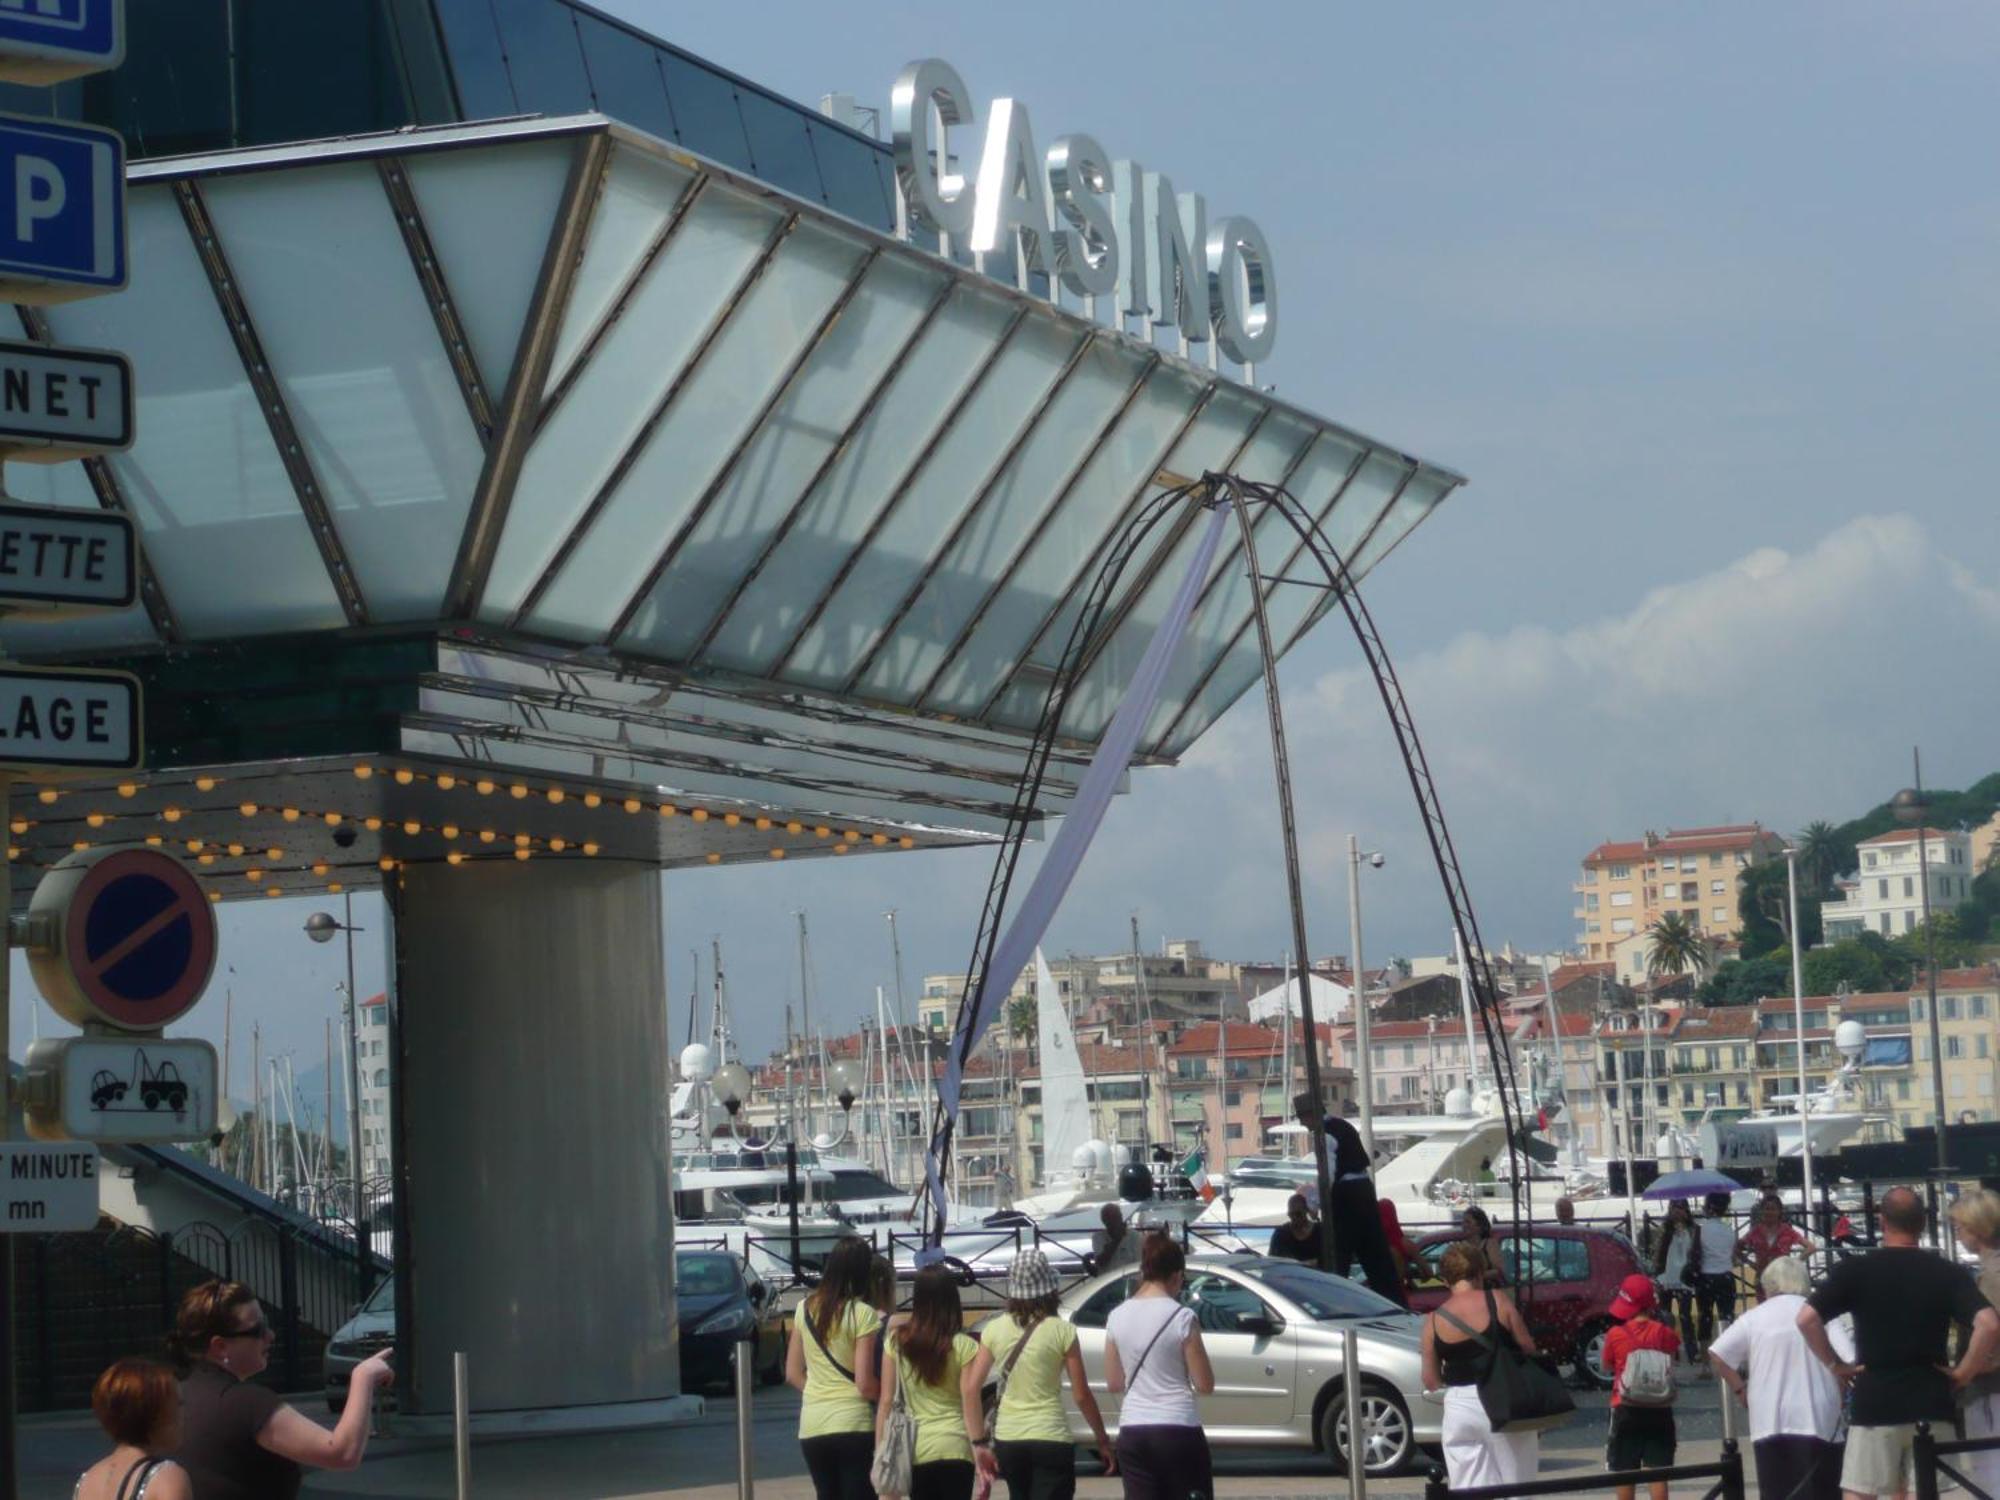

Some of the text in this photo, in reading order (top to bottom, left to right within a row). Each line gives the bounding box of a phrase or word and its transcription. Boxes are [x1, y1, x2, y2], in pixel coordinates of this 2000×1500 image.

[15, 153, 66, 243] P
[892, 57, 1277, 364] CASINO
[4, 368, 102, 420] NET
[0, 531, 107, 581] ETTE
[11, 1153, 94, 1179] MINUTE
[9, 1201, 45, 1219] mn
